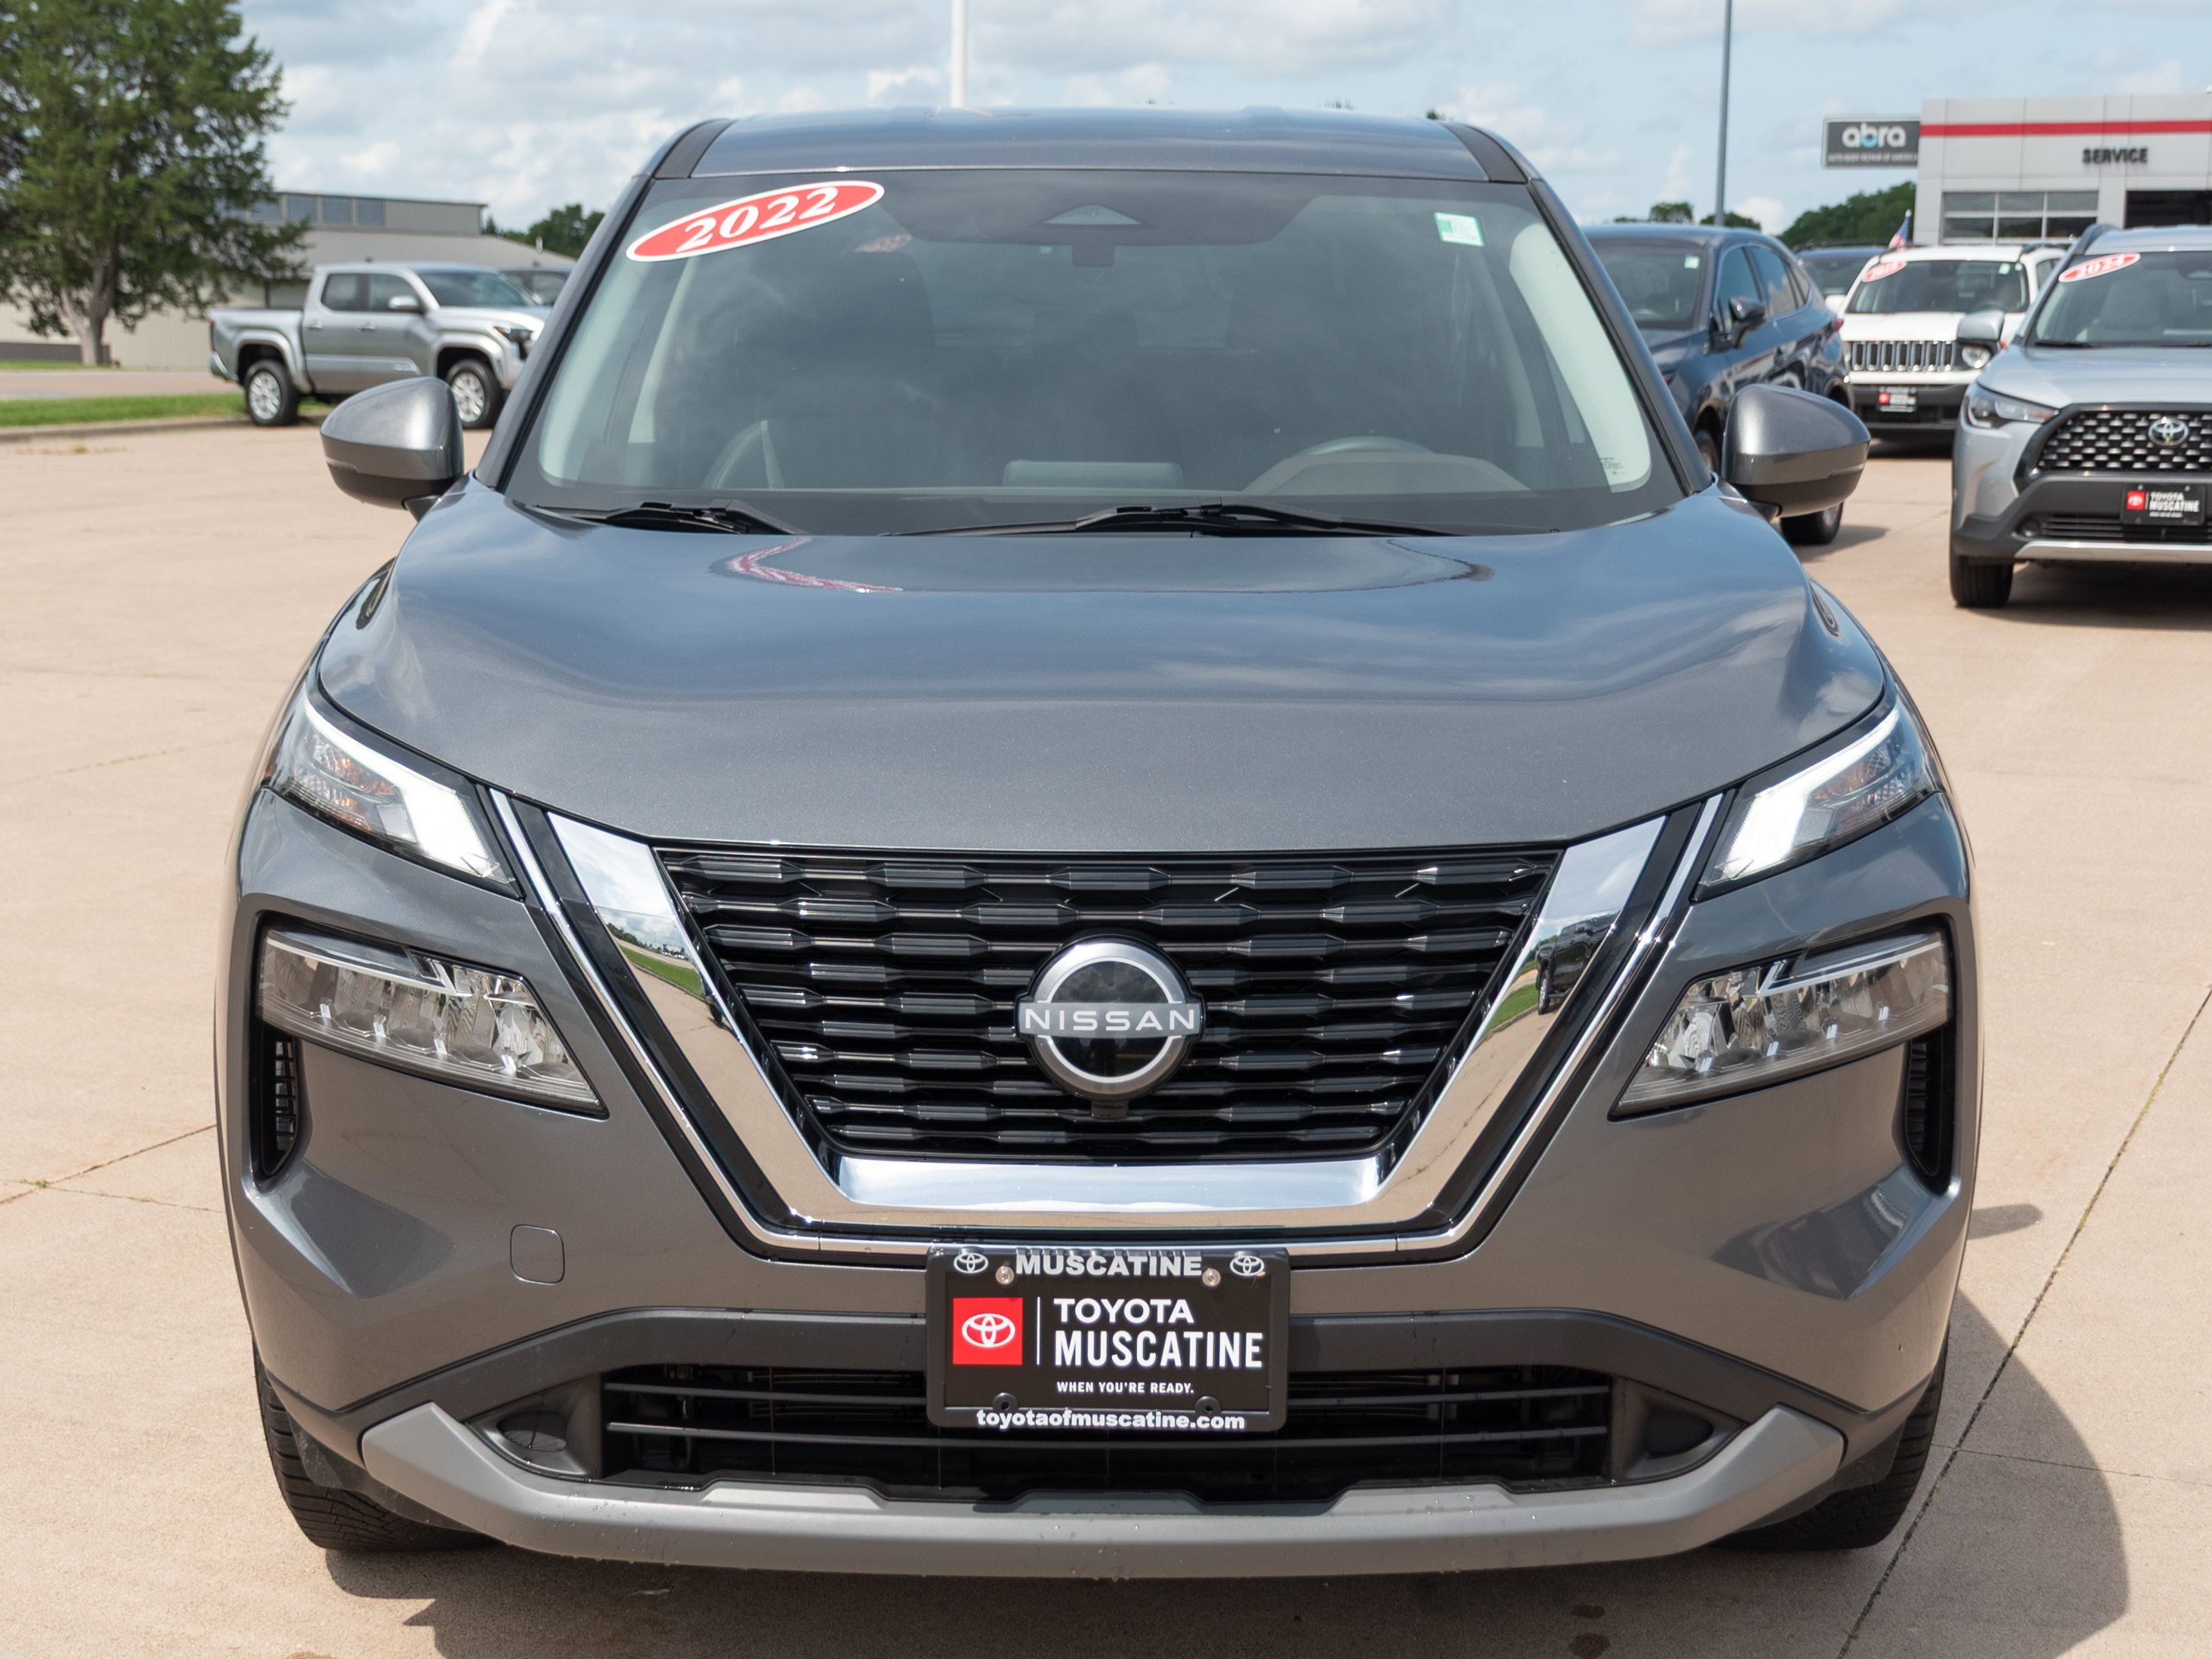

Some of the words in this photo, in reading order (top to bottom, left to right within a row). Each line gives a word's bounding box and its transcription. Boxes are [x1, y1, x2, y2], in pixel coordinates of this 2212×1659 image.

[1842, 122, 1906, 149] abra
[2082, 148, 2149, 164] SERVICE
[676, 186, 839, 253] 2022
[2149, 499, 2200, 512] MUSCATINE
[2150, 491, 2185, 501] TOYOTA
[1025, 1008, 1194, 1031] NISSAN
[1016, 1254, 1203, 1277] MUSCATINE
[1053, 1298, 1195, 1324] TOYOTA
[1055, 1329, 1264, 1369] MUSCATINE
[1057, 1381, 1094, 1393] WHEN
[1098, 1381, 1146, 1394] YOU'RE
[1150, 1382, 1194, 1394] READY.
[976, 1409, 1245, 1430] toyotaofmuscatine.com
